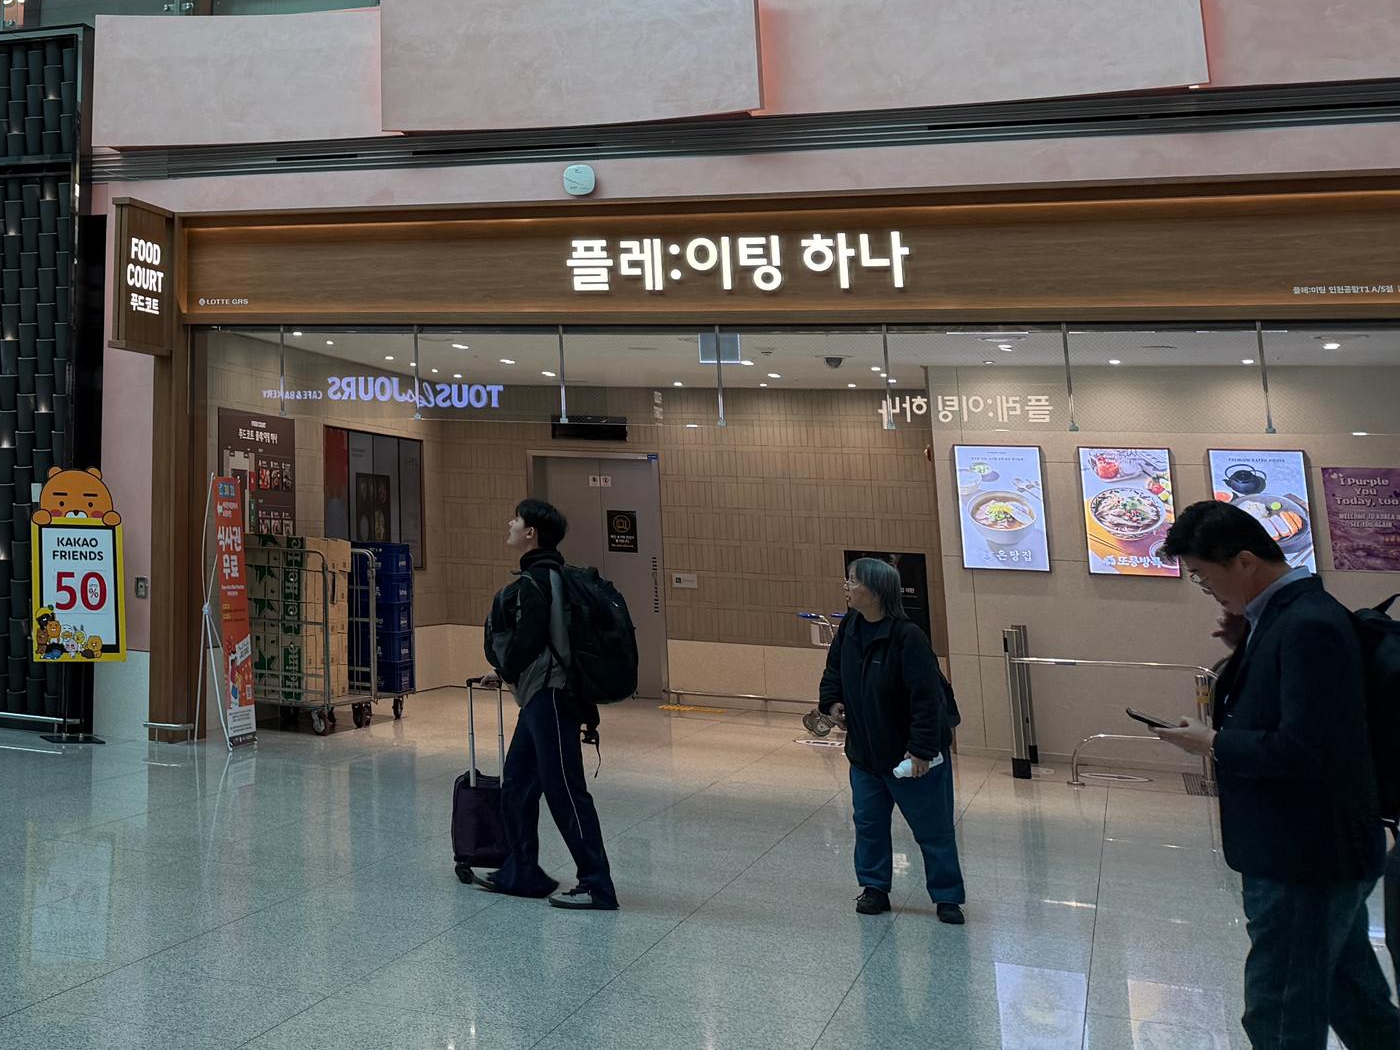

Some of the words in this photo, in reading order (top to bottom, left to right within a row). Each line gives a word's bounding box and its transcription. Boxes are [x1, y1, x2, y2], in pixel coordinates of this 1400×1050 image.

[131, 237, 161, 266] FOOD
[566, 234, 783, 292] 플레:이팅
[800, 231, 910, 289] 하나
[127, 263, 164, 293] COURT
[130, 293, 160, 315] 푸드코트
[1348, 477, 1390, 488] Purple
[1355, 488, 1378, 496] You
[1335, 497, 1376, 507] Today,
[57, 537, 99, 548] KAKAO
[218, 526, 242, 551] 식사권
[52, 550, 104, 561] FRIENDS
[55, 571, 107, 611] 50
